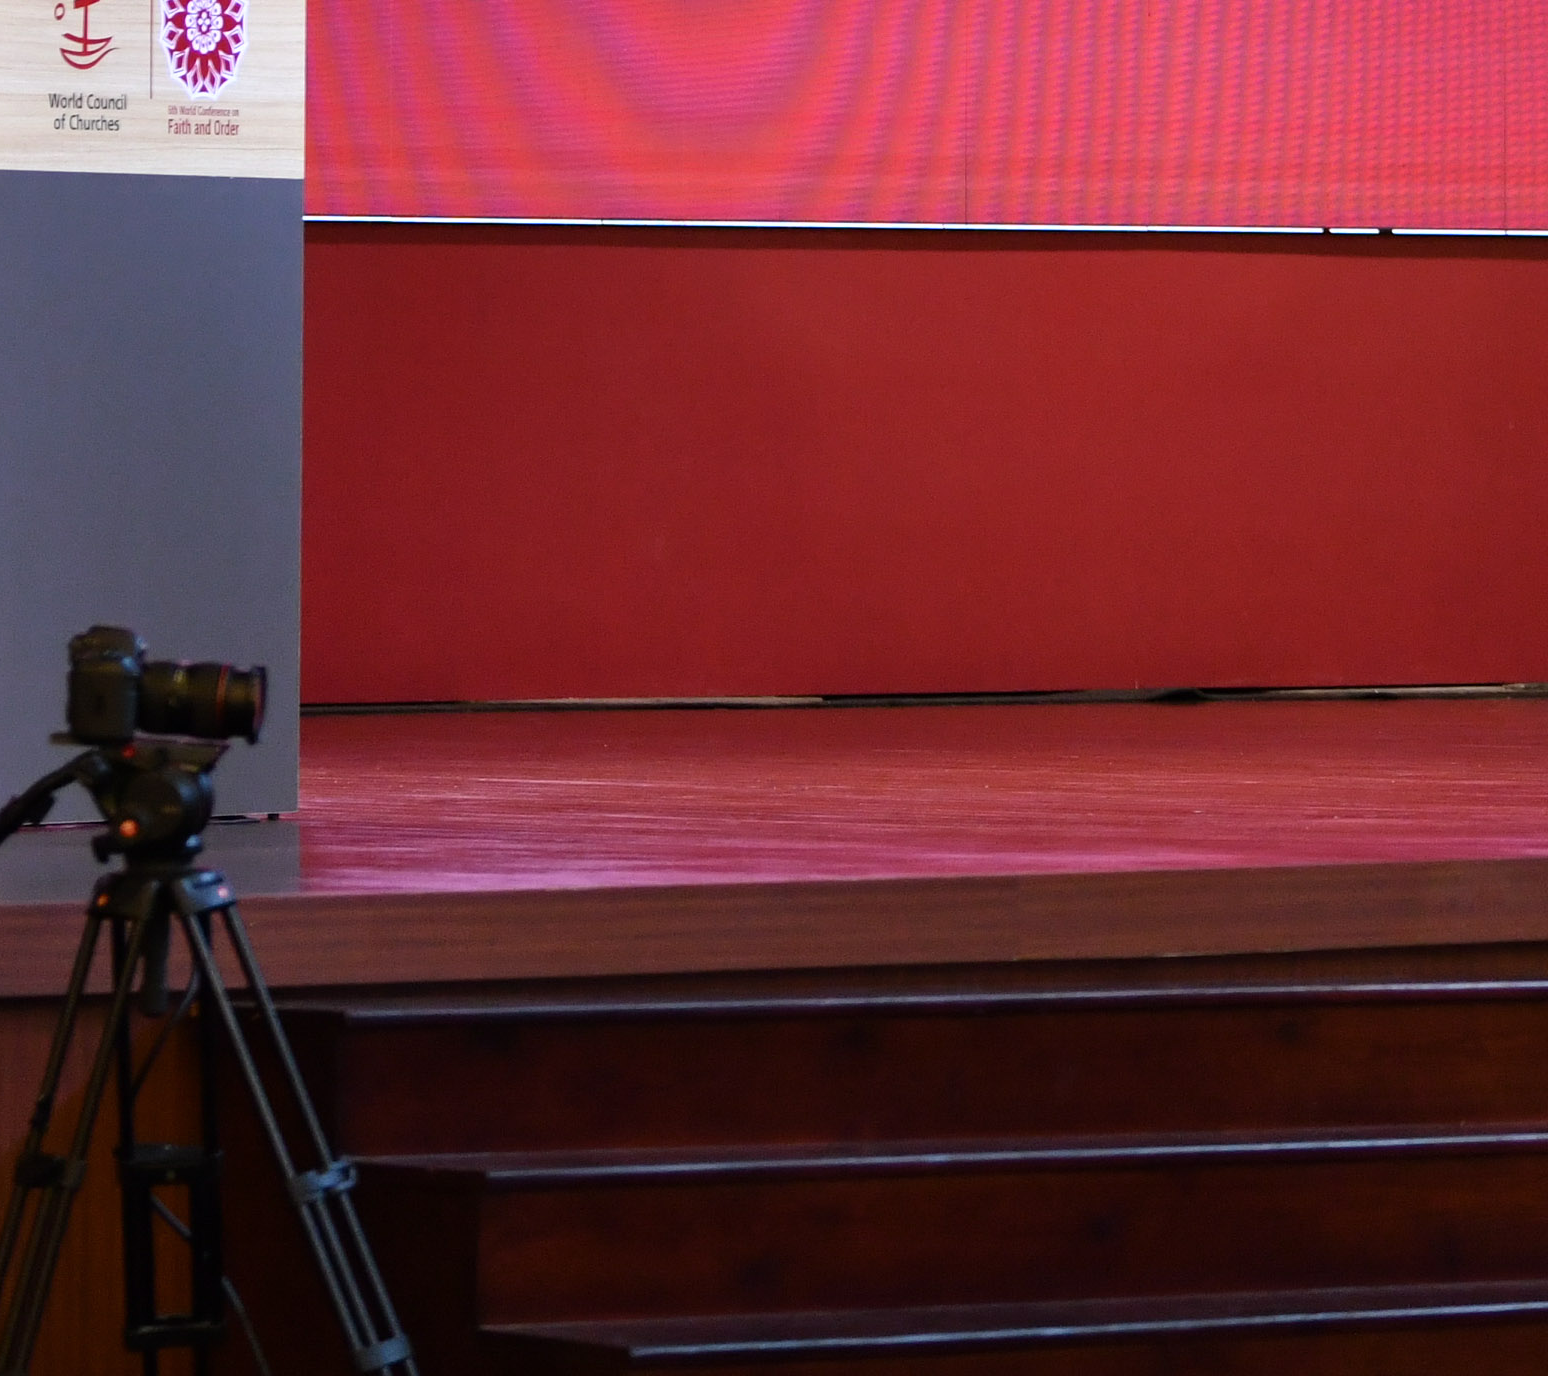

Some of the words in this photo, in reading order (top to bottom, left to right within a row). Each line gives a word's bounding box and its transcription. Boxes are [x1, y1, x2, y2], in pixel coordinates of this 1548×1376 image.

[49, 93, 83, 109] World
[87, 93, 127, 110] Council
[53, 114, 66, 130] of
[69, 114, 120, 131] Churches
[168, 118, 191, 134] Faith
[194, 119, 211, 135] and
[214, 119, 239, 135] Order
